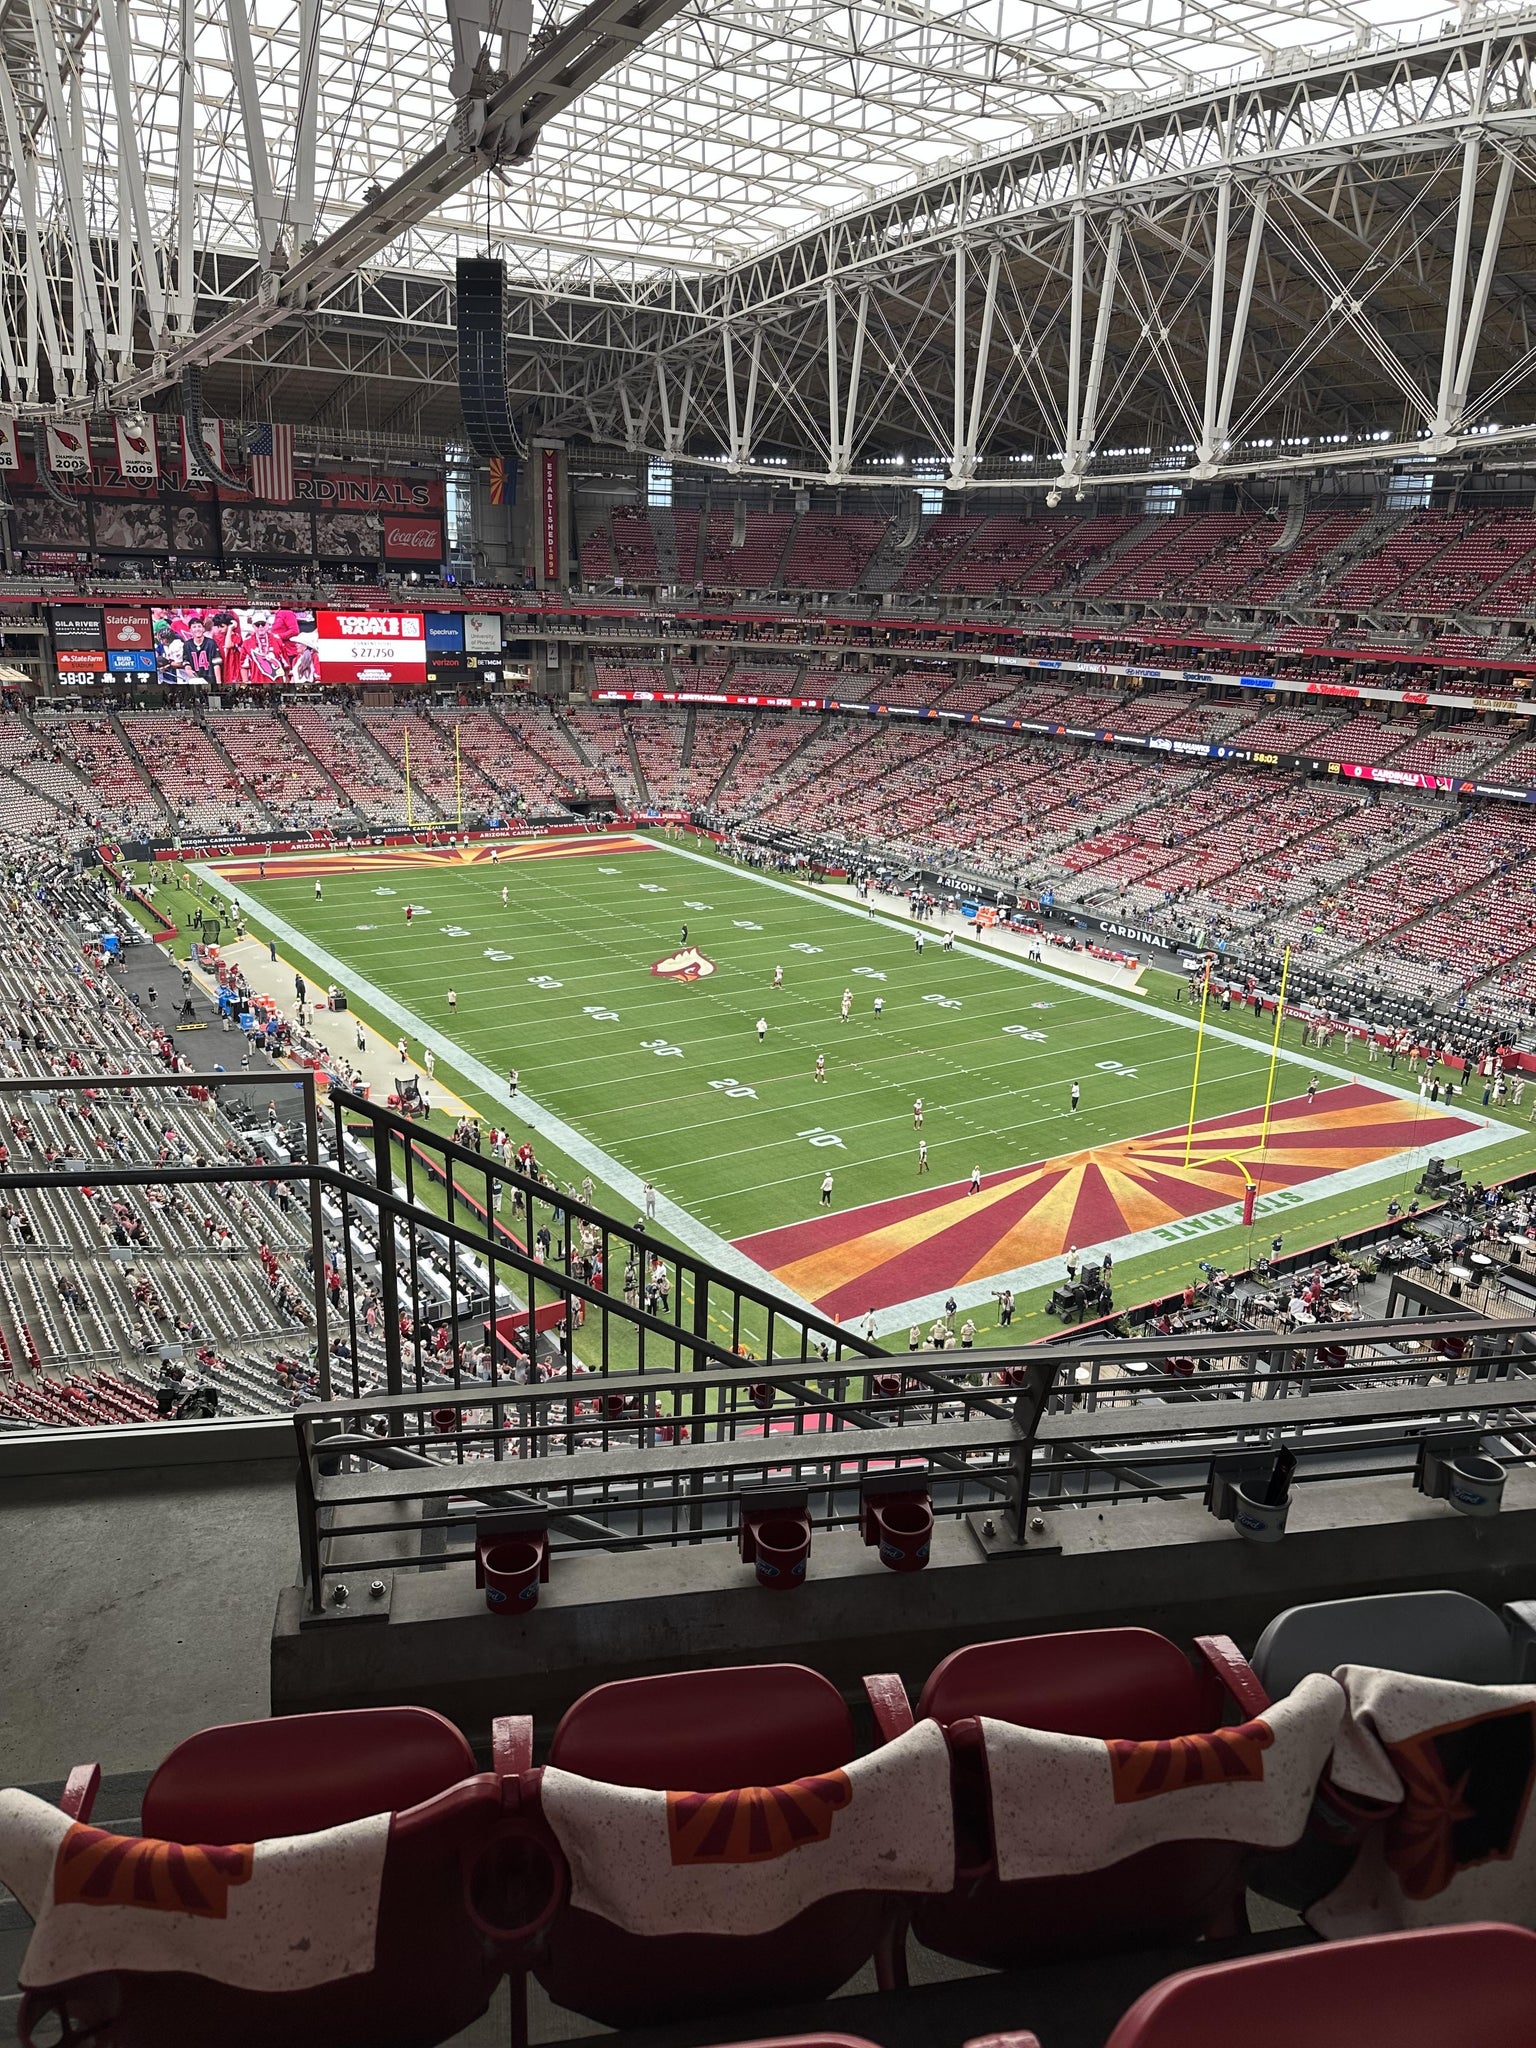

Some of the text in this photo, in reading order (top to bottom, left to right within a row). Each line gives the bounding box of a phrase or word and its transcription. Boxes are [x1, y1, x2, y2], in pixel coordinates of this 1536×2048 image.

[126, 465, 153, 474] 2009
[387, 527, 437, 548] Coca-Cola
[341, 624, 399, 635] RAFFLE
[429, 628, 457, 636] Spectrum
[191, 652, 209, 670] 14
[432, 658, 459, 666] verizon
[58, 672, 94, 685] 58:02
[1182, 672, 1211, 681] Spectrum
[1472, 698, 1518, 709] GILA RIVER
[1173, 741, 1210, 753] SEAHAWKS
[1253, 753, 1278, 764] 58:02
[1371, 768, 1419, 783] CARDINALS
[290, 842, 326, 850] ARIZONA
[483, 948, 514, 962] 40
[527, 974, 564, 989] 50
[921, 993, 963, 1008] 30
[582, 1006, 618, 1022] 40
[1001, 1024, 1049, 1041] 20
[640, 1039, 680, 1057] 30
[1095, 1060, 1134, 1077] 10
[707, 1078, 755, 1099] 20
[796, 1126, 843, 1148] 10
[1152, 1212, 1232, 1241] HATE
[1454, 1487, 1480, 1505] Ford
[1238, 1513, 1260, 1530] Ford
